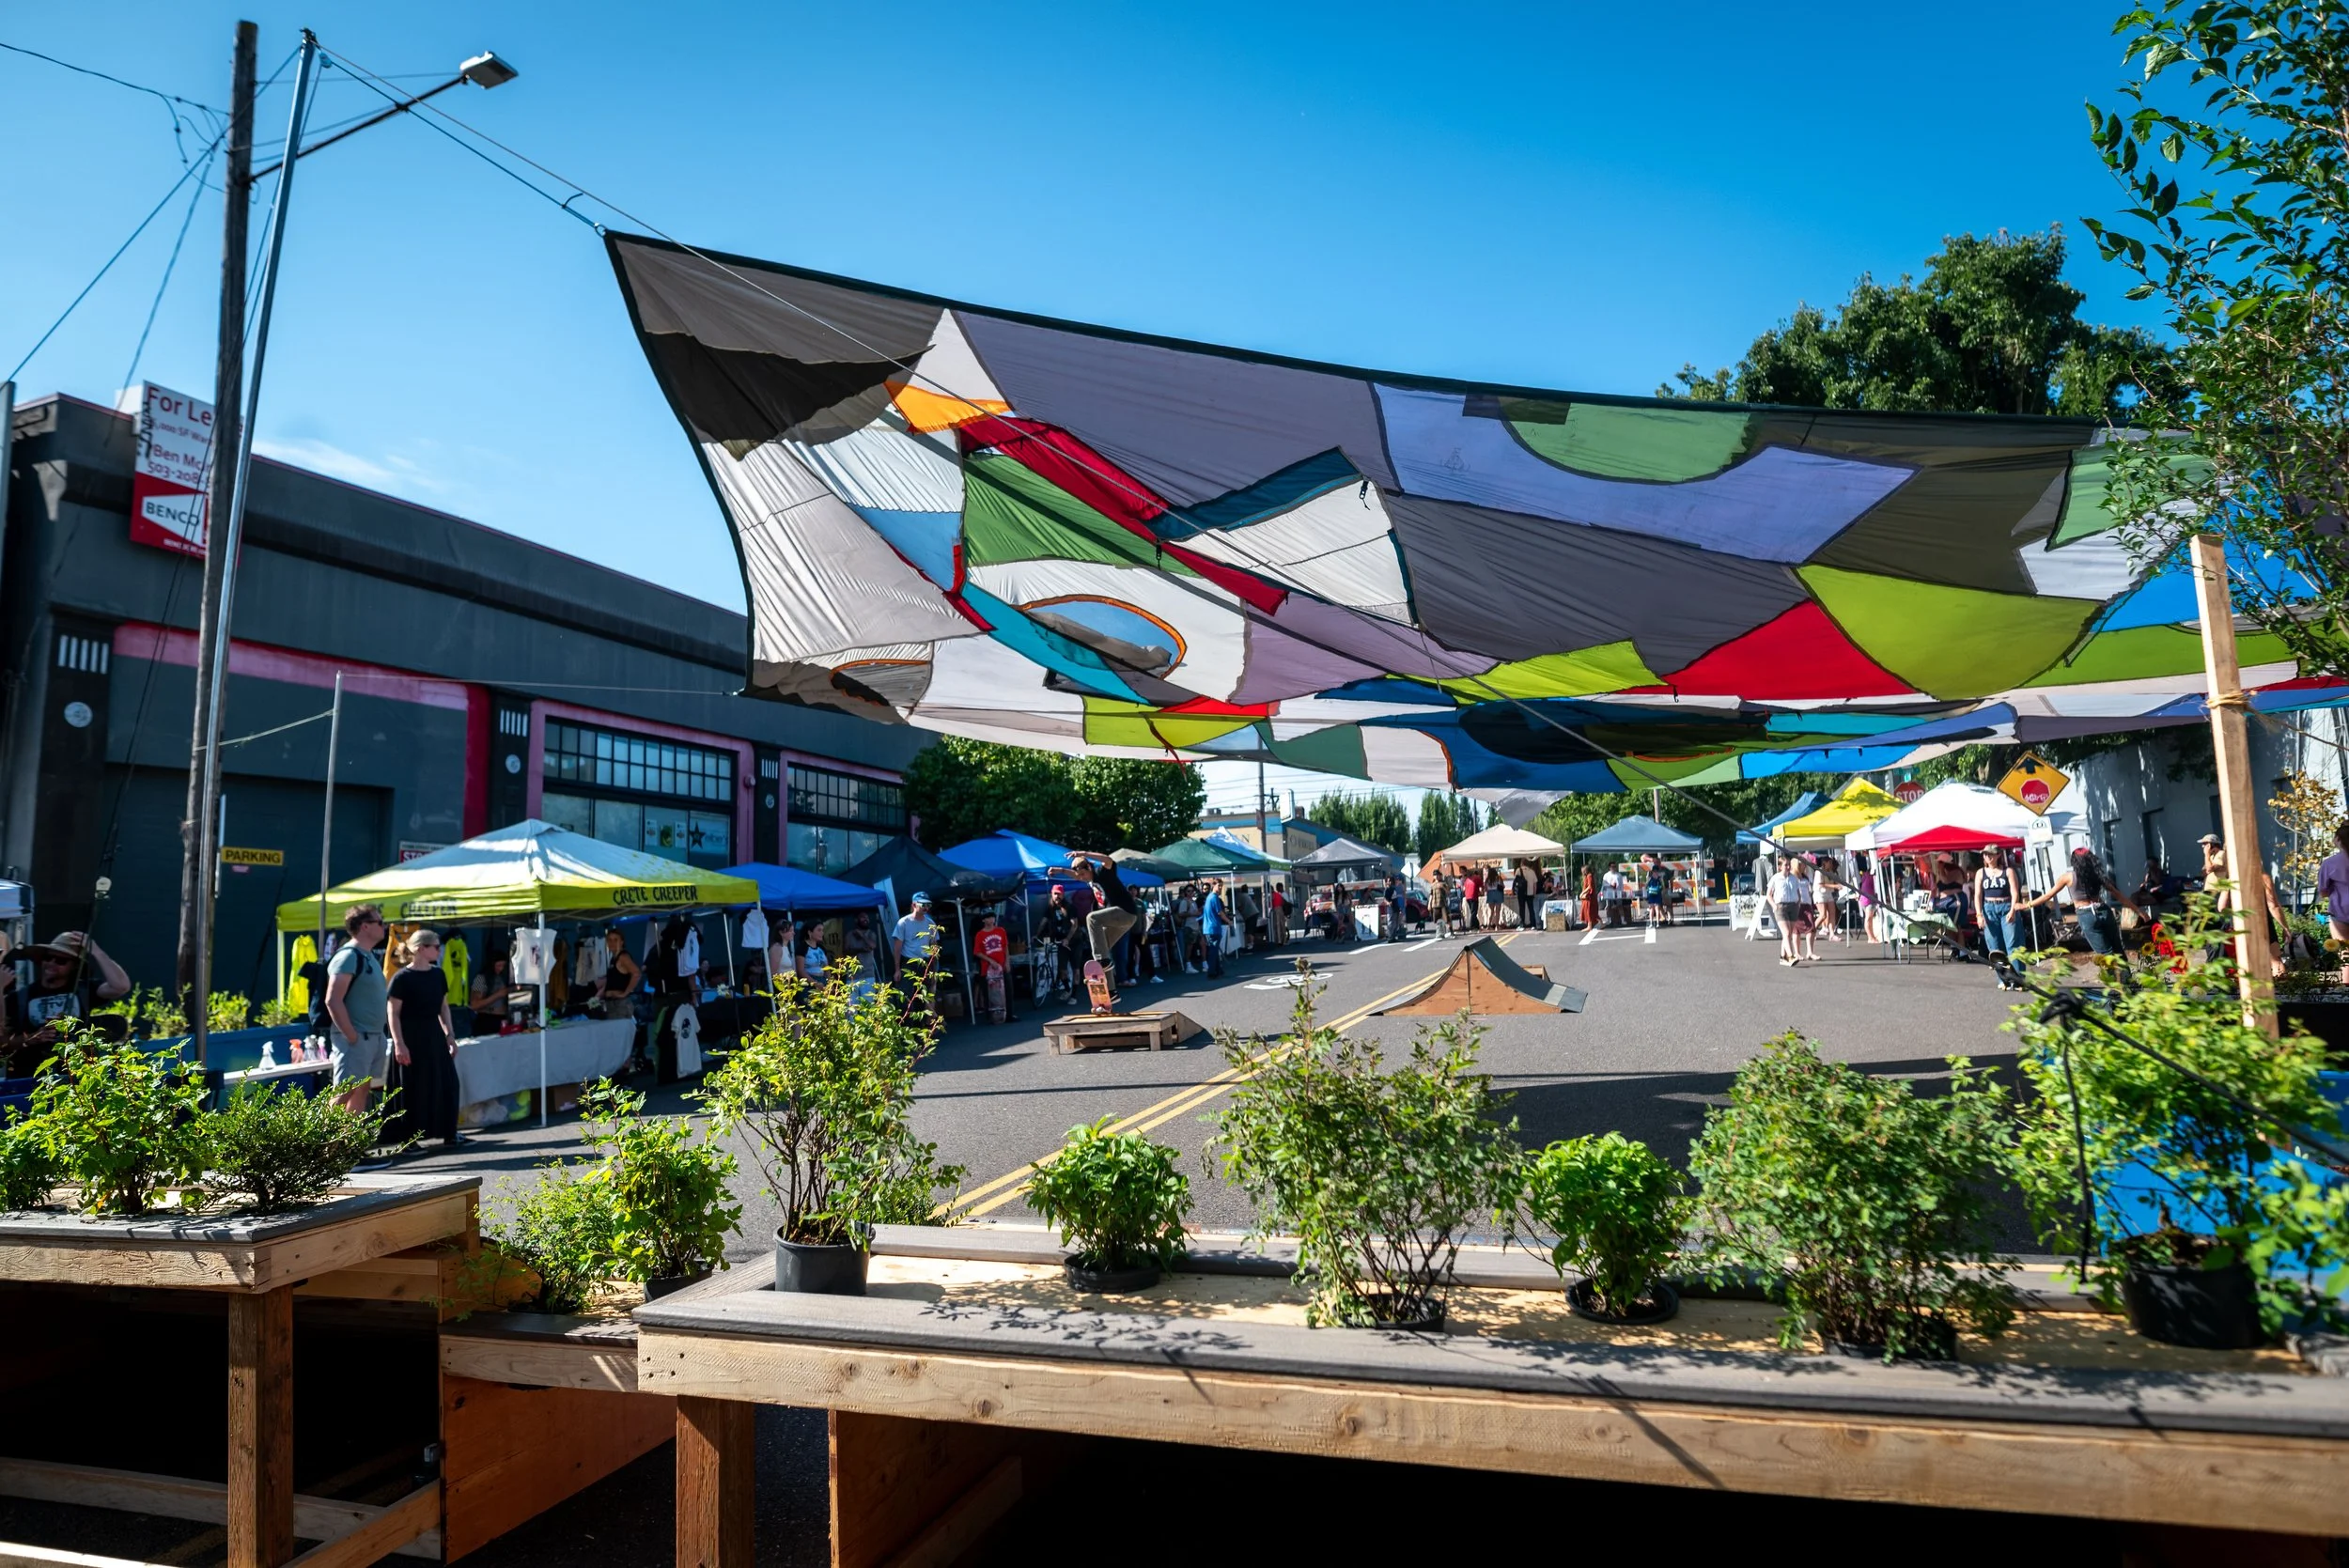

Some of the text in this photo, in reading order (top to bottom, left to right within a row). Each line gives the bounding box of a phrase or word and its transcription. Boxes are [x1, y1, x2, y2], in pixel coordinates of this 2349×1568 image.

[147, 386, 183, 415] For
[153, 443, 179, 463] Ben
[146, 501, 200, 527] BENCO
[1896, 789, 1924, 803] STOP
[226, 849, 280, 863] PARKING
[613, 886, 698, 905] CRETE CREEPER
